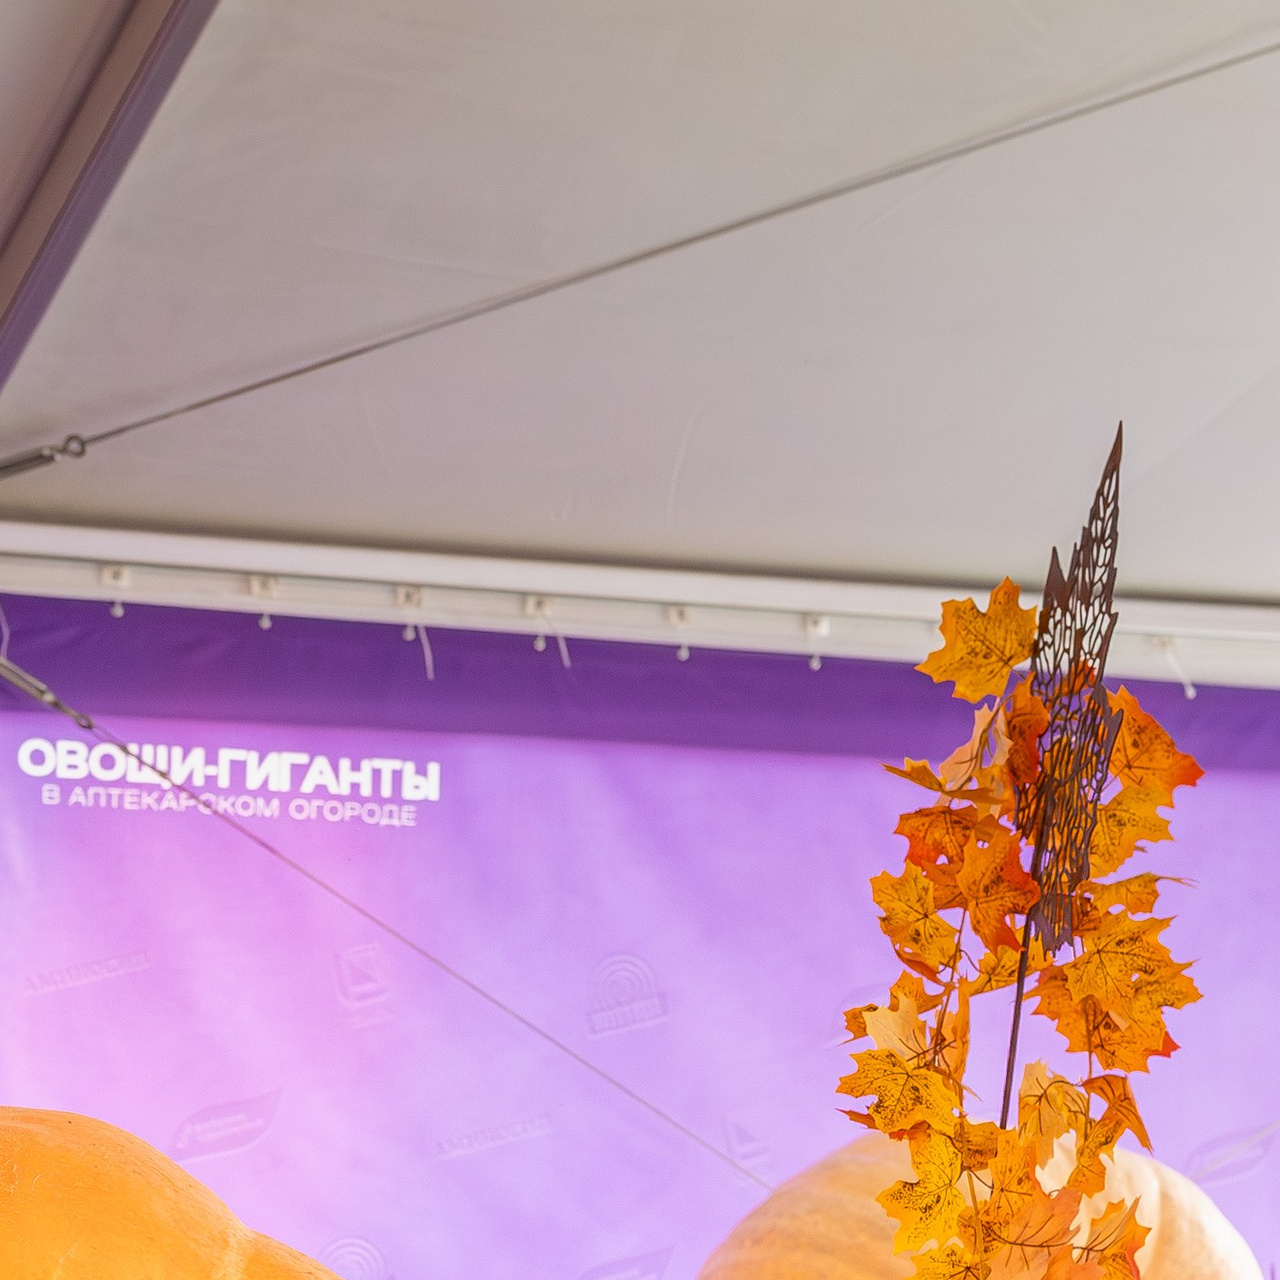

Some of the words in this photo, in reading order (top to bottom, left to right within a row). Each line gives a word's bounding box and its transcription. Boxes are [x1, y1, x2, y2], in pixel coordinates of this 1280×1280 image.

[17, 737, 441, 801] ОВОЩИ-ГИГАНТЫ
[41, 783, 60, 805] В
[67, 785, 280, 819] АПТЕКАРСКОМ
[287, 802, 419, 827] ОГОРОДЕ
